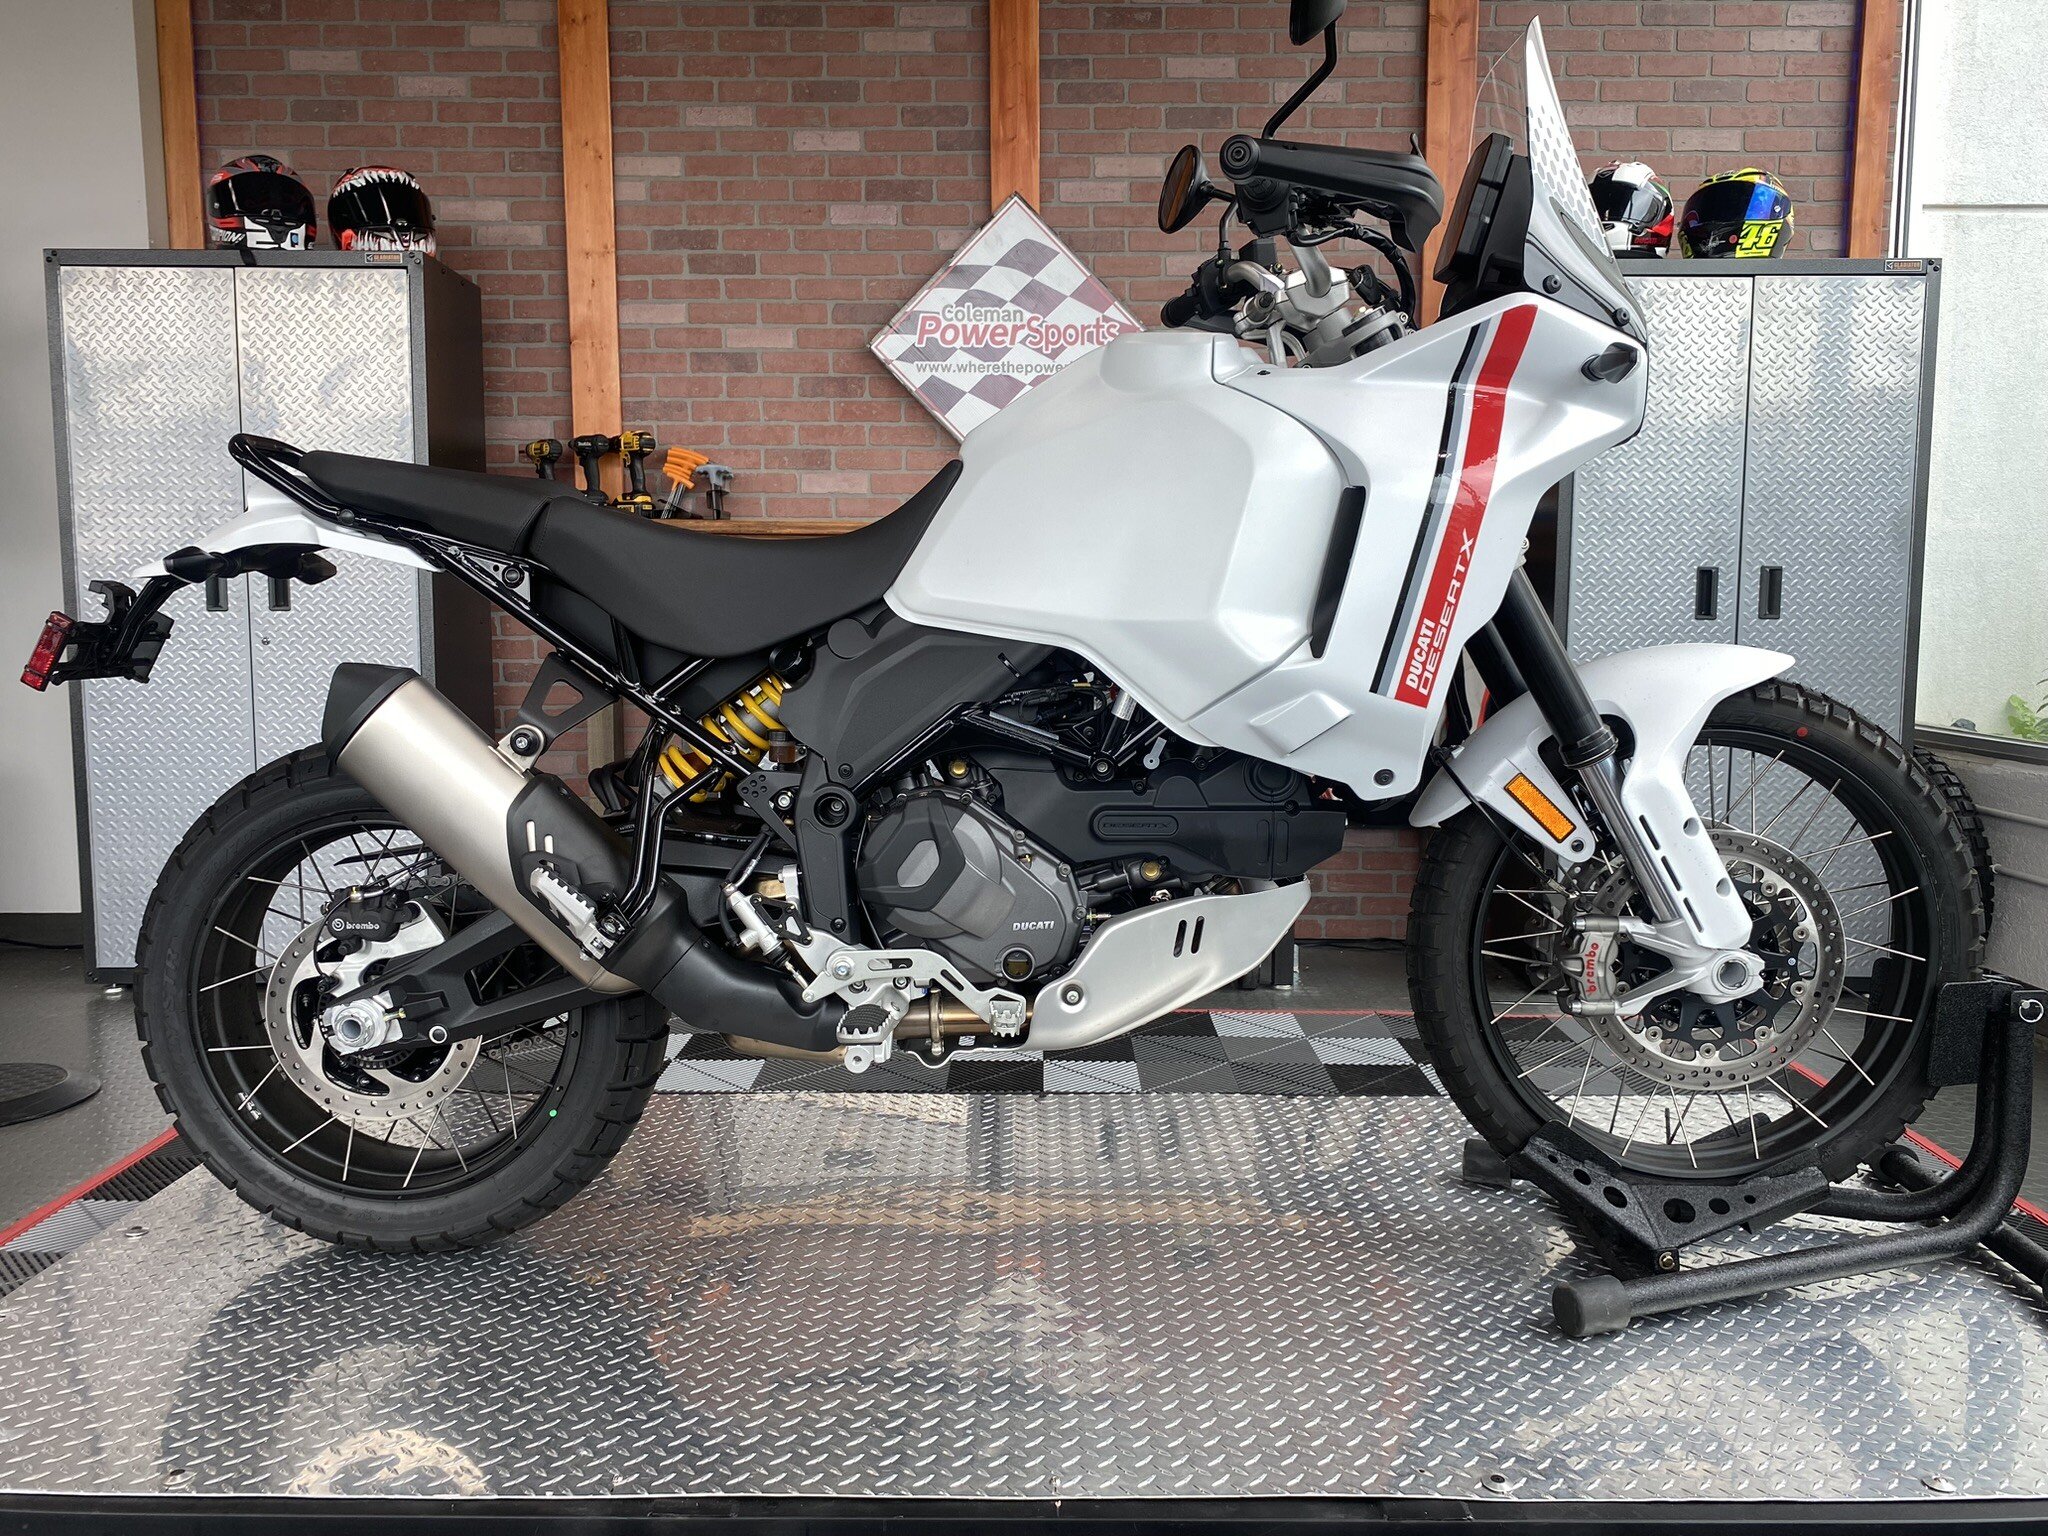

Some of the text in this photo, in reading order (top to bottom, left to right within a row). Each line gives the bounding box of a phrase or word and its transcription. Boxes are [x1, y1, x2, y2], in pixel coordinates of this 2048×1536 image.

[1738, 222, 1782, 249] 46
[941, 303, 1024, 323] Coleman
[916, 315, 1121, 353] PowerSports
[916, 360, 1069, 376] www.wherethepowe
[1418, 527, 1475, 697] DESERTX
[1405, 617, 1436, 690] DUCATI
[345, 921, 380, 930] brembo
[1012, 920, 1055, 931] DUCATI
[1585, 943, 1599, 994] brembo
